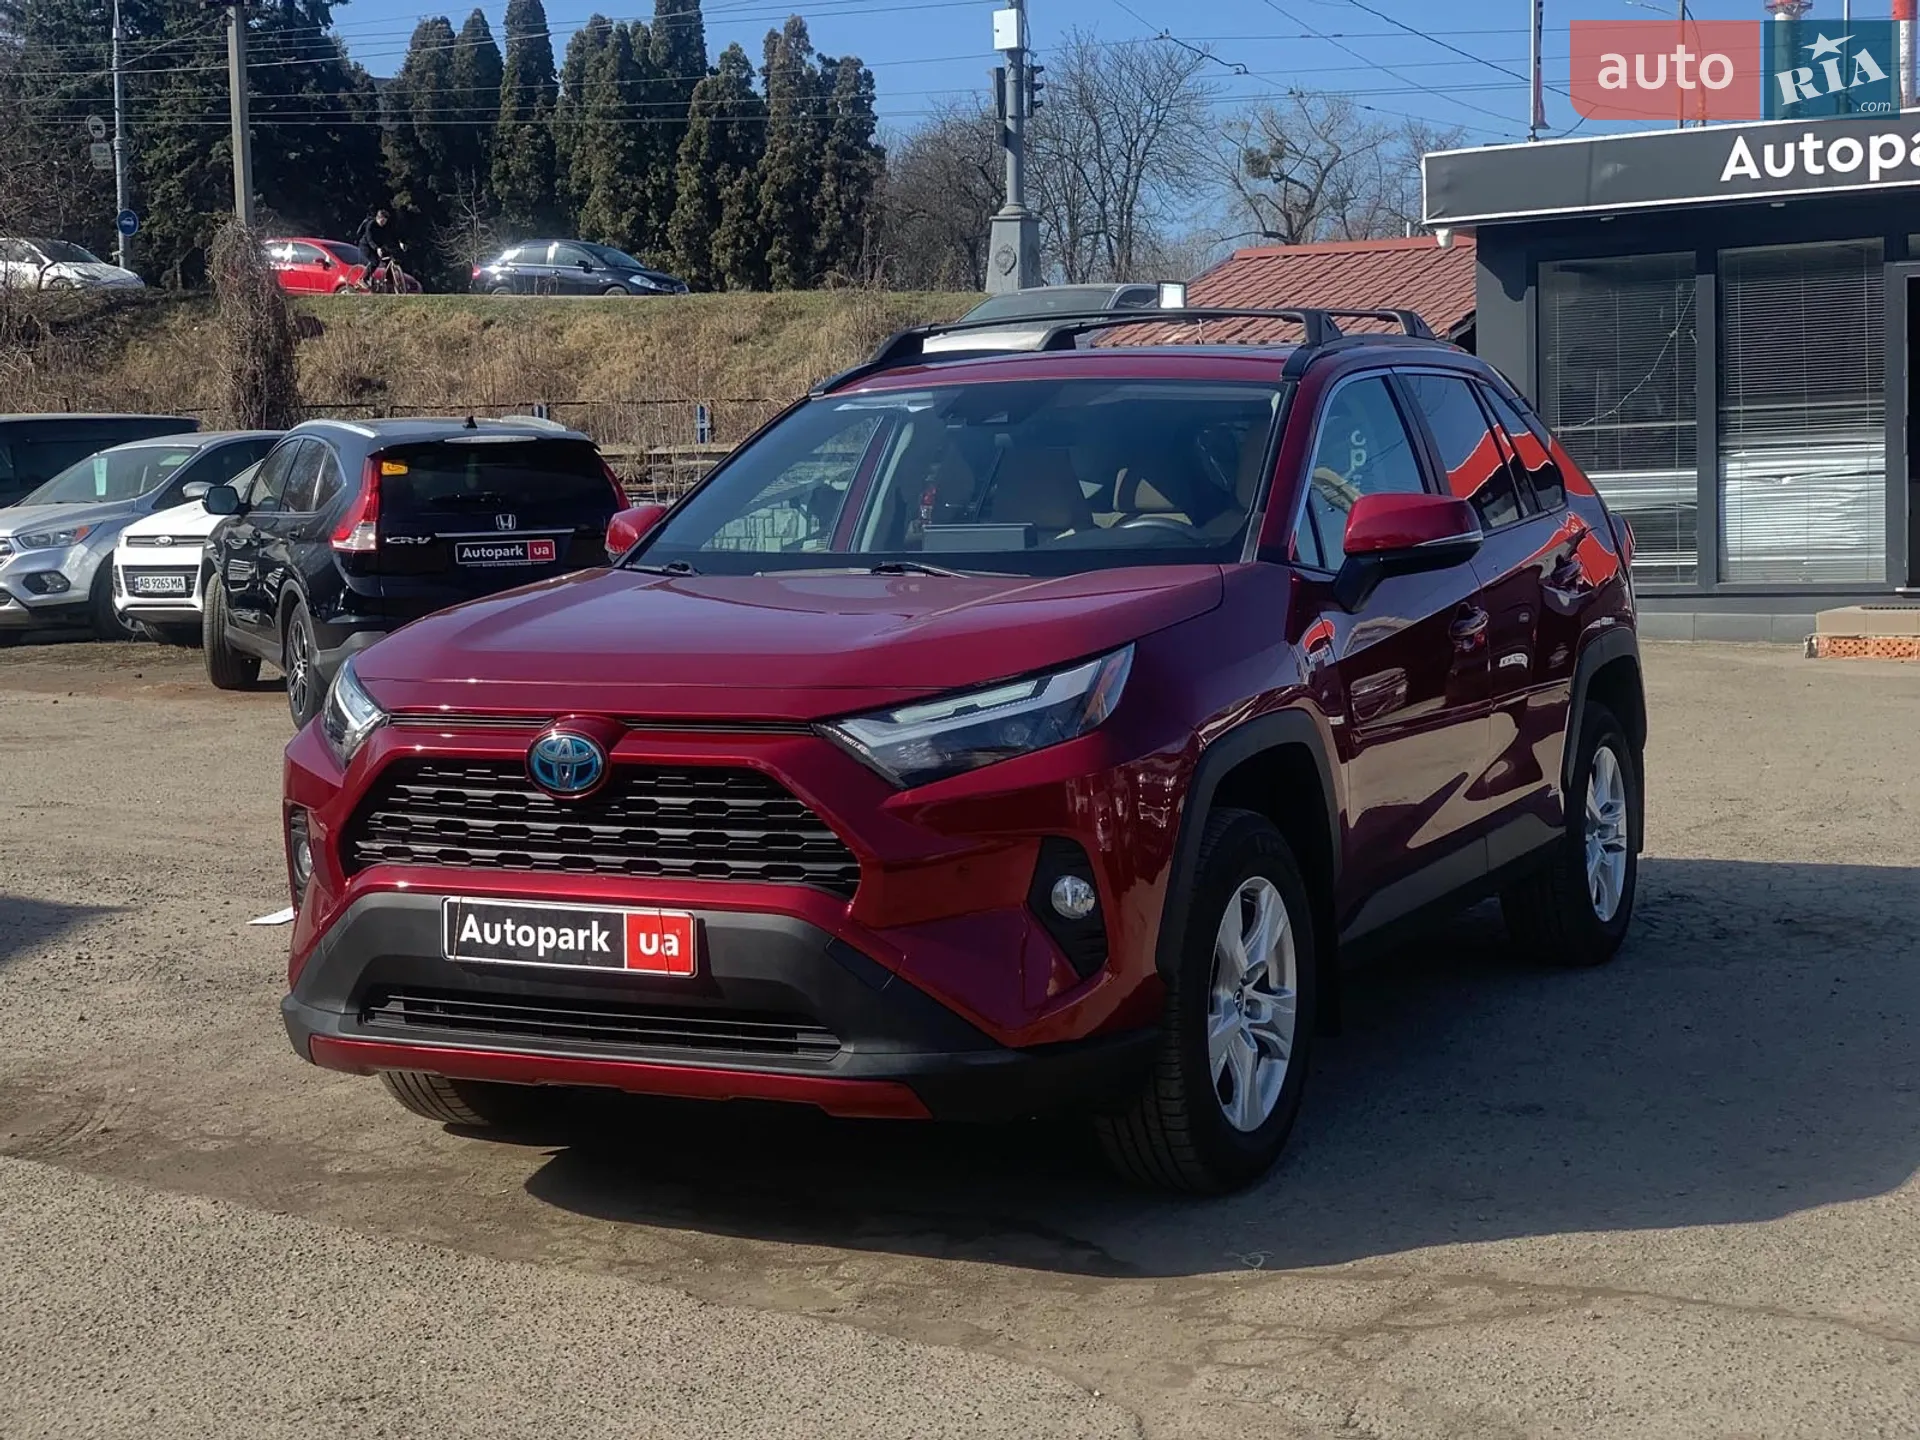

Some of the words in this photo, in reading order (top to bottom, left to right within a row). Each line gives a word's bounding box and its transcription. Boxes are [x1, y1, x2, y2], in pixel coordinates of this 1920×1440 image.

[1720, 131, 1920, 182] Autop
[462, 544, 524, 560] Autopark
[534, 545, 550, 556] ua
[460, 913, 611, 957] Autopark
[639, 931, 679, 957] ua
